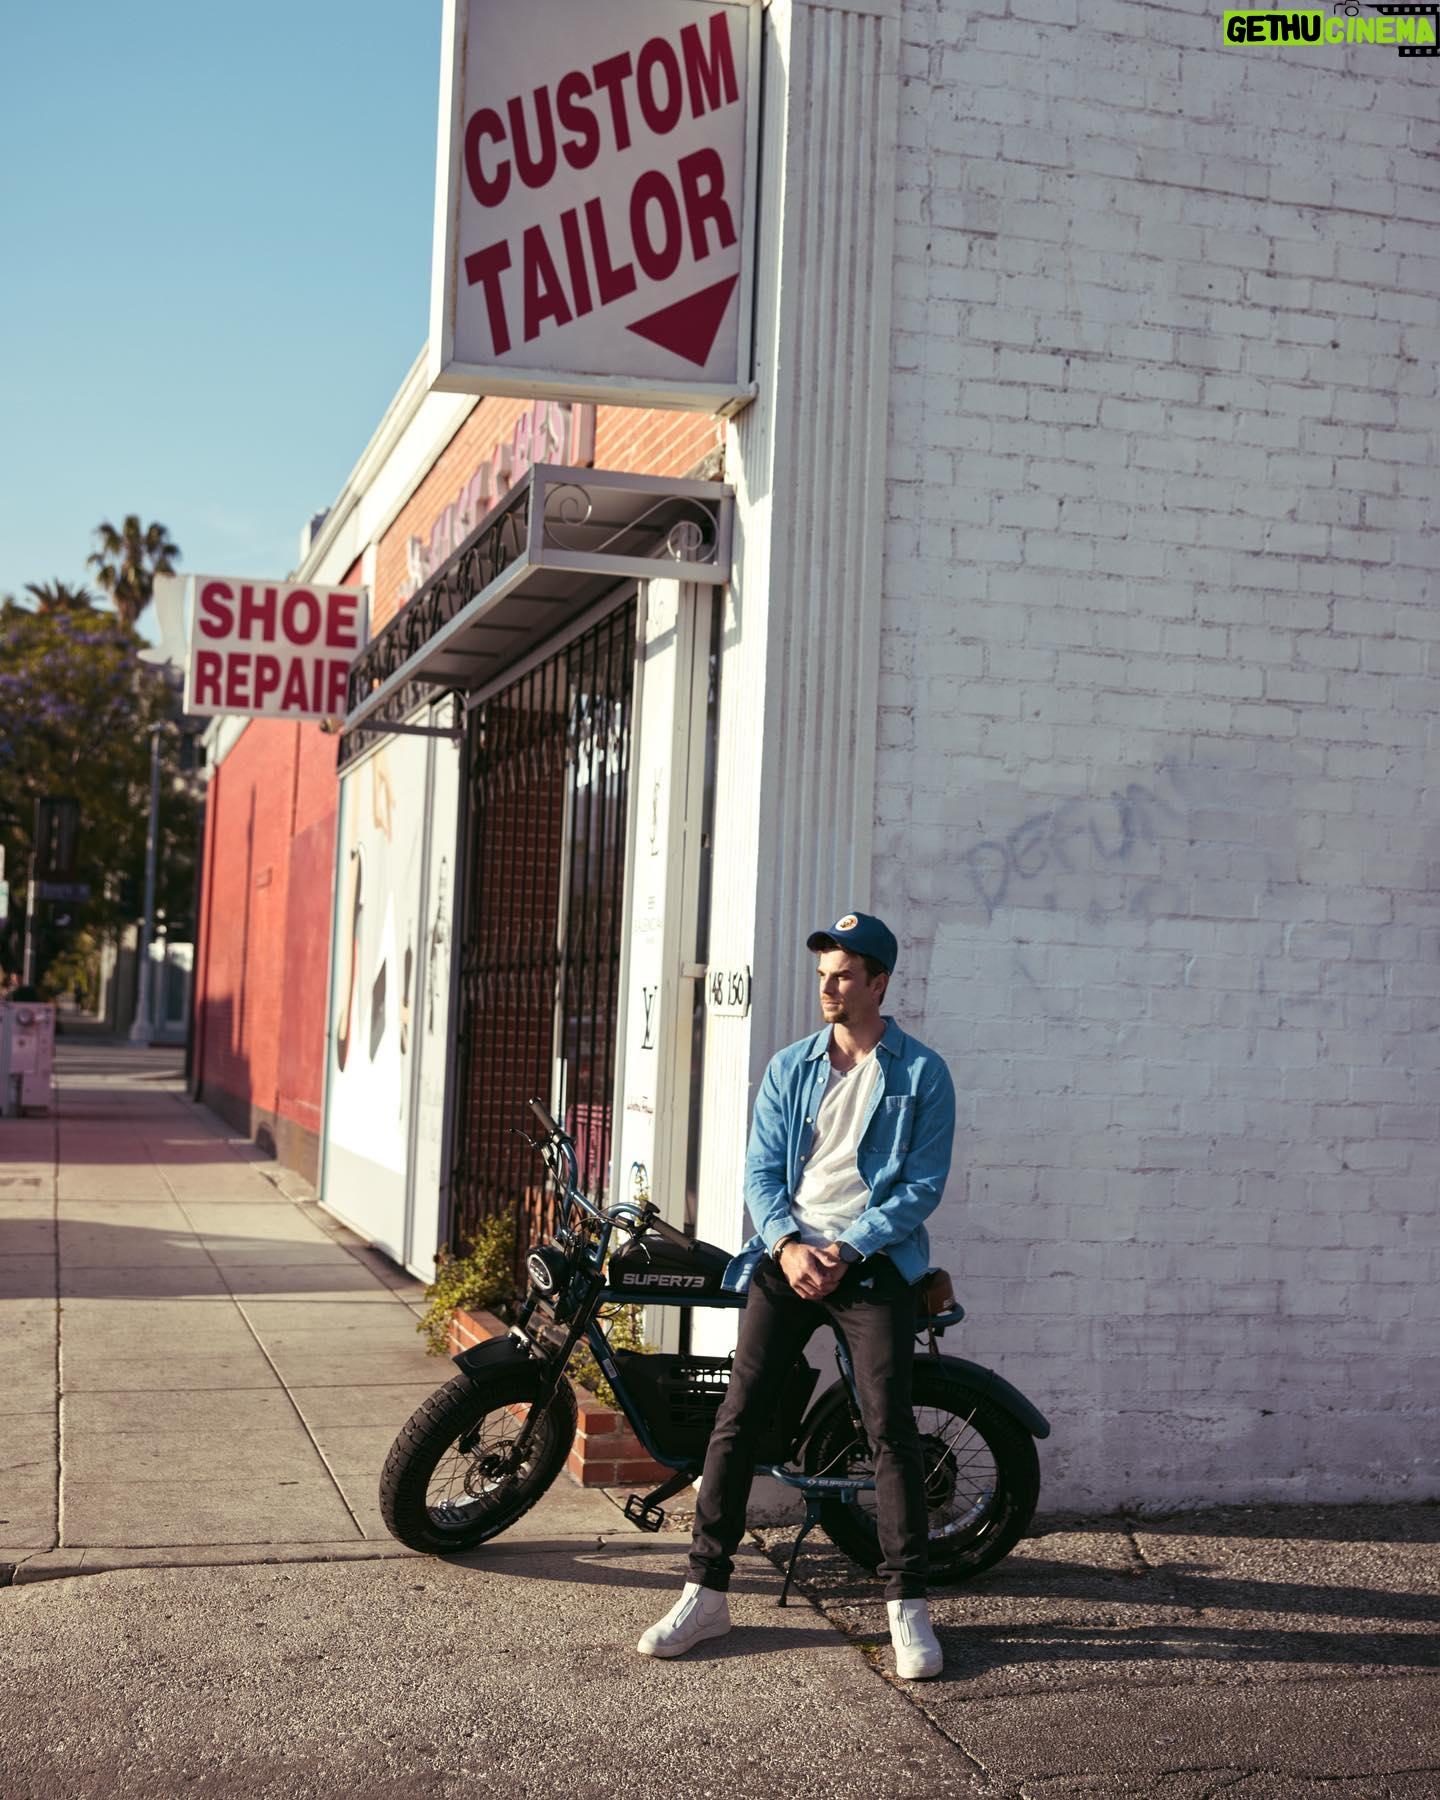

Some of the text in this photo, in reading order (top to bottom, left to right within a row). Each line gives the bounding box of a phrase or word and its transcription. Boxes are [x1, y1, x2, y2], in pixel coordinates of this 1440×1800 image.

[464, 11, 739, 208] CUSTOM
[464, 147, 738, 357] TAILOR
[199, 581, 358, 648] SHOE
[622, 1273, 705, 1288] SUPER73
